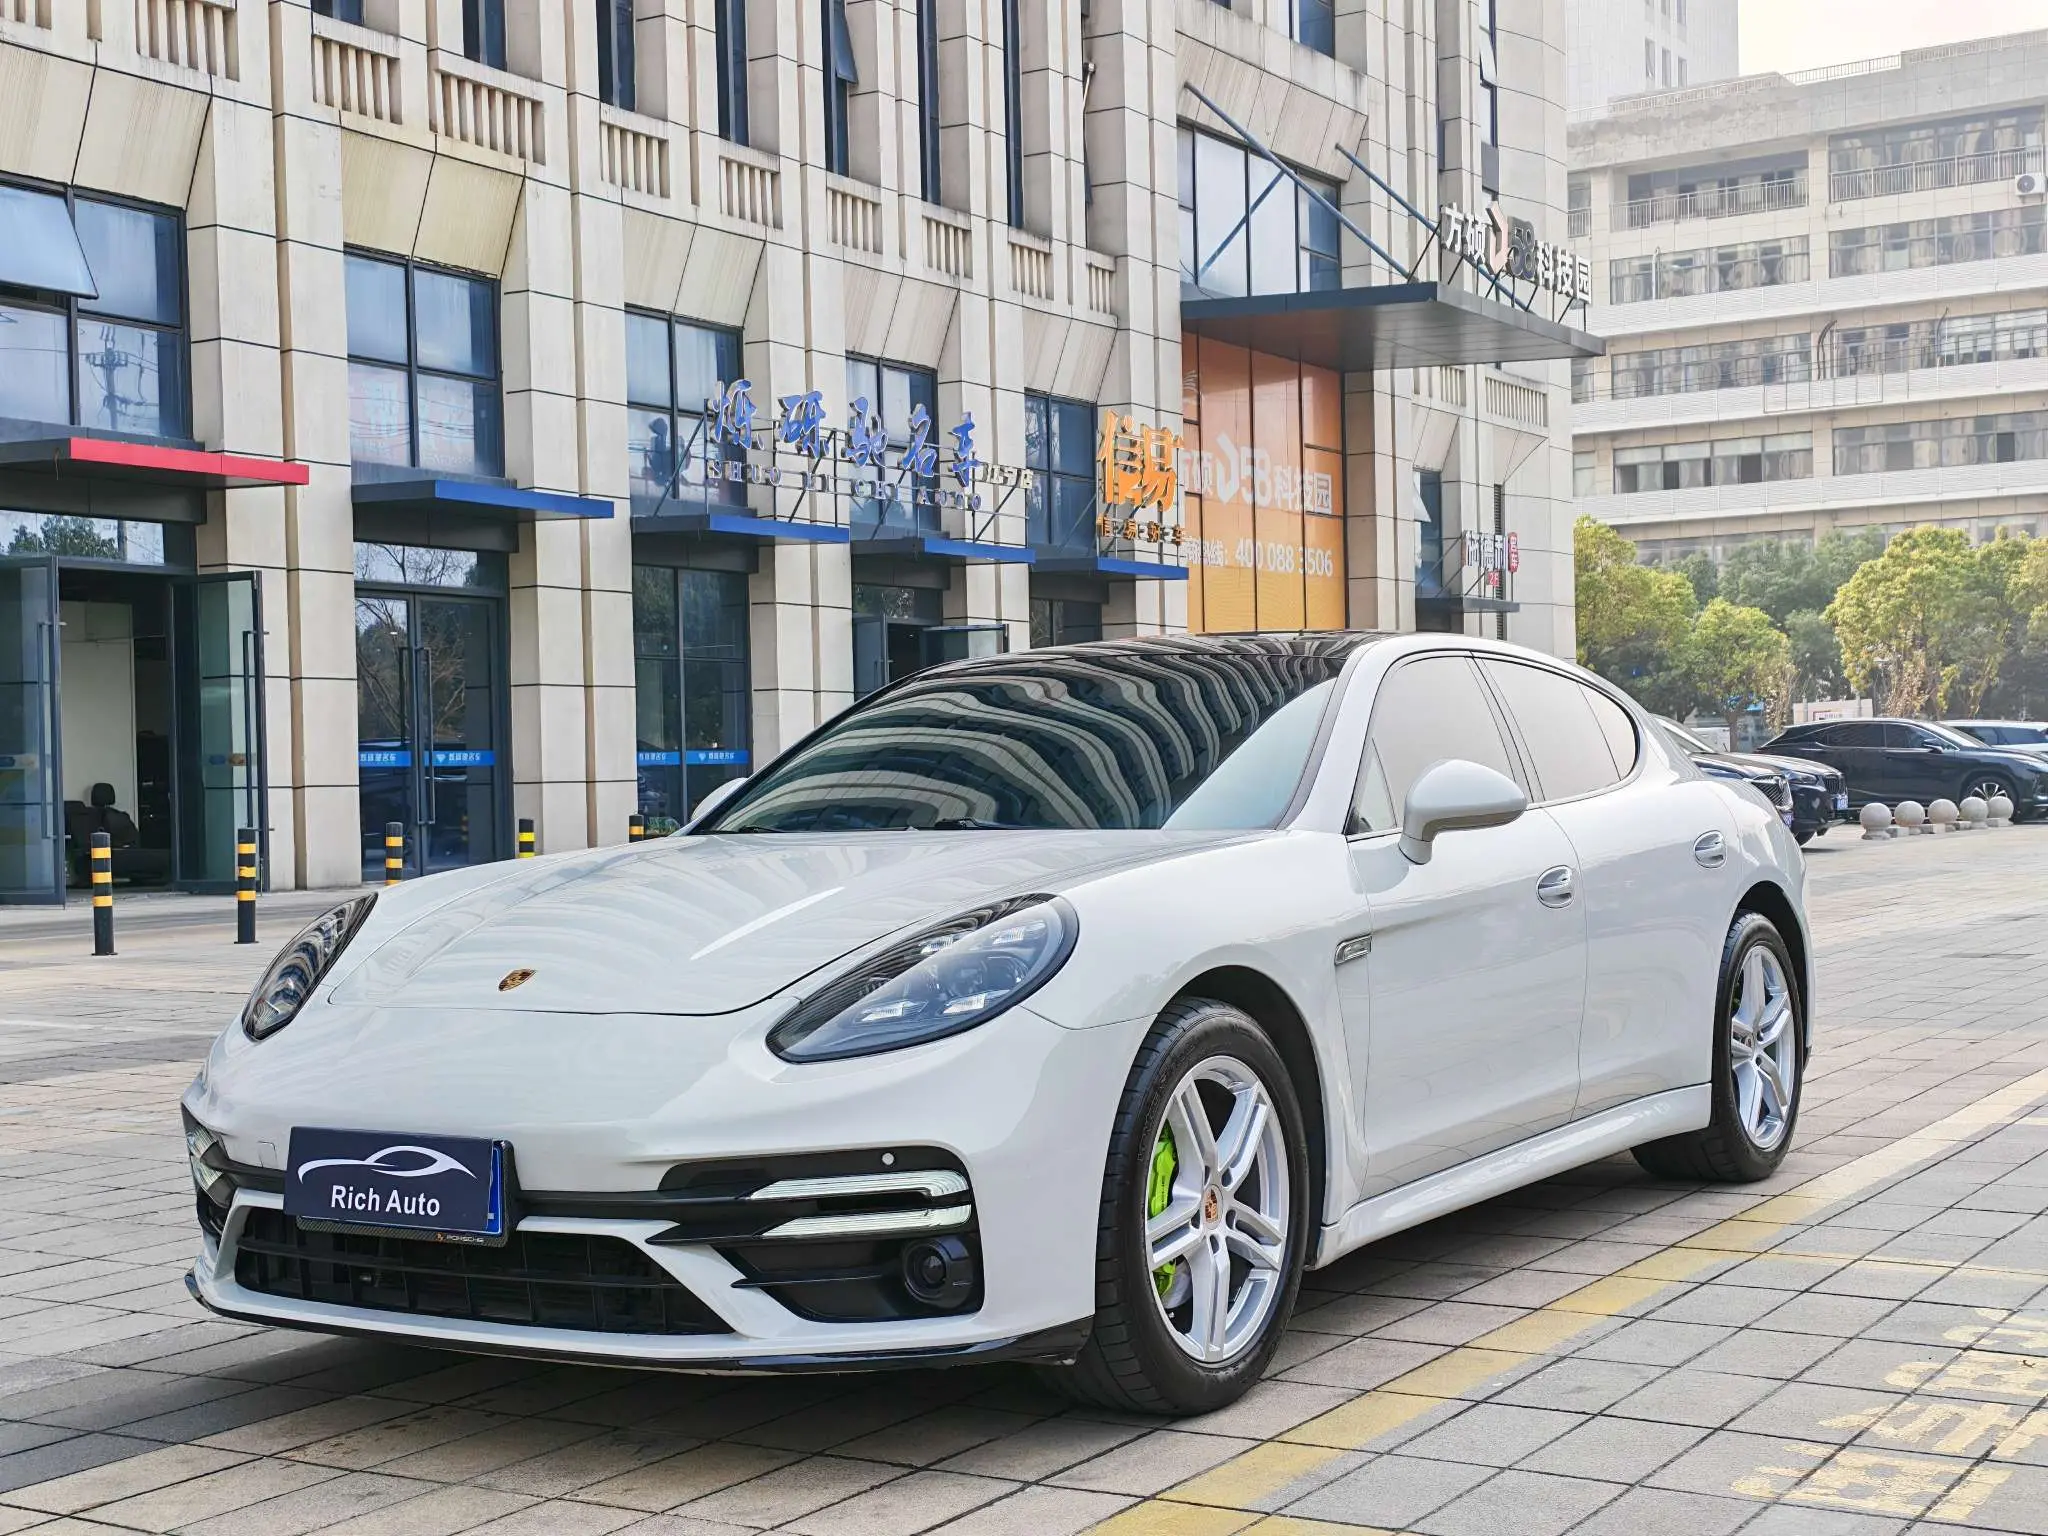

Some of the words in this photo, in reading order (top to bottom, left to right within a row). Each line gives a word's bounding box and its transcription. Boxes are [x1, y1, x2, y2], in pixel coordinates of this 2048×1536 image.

[1097, 408, 1184, 512] 信易
[1235, 538, 1263, 570] 400
[1267, 542, 1295, 572] 088
[1299, 548, 1333, 577] 3506
[331, 1184, 380, 1213] Rich
[385, 1189, 441, 1217] Auto
